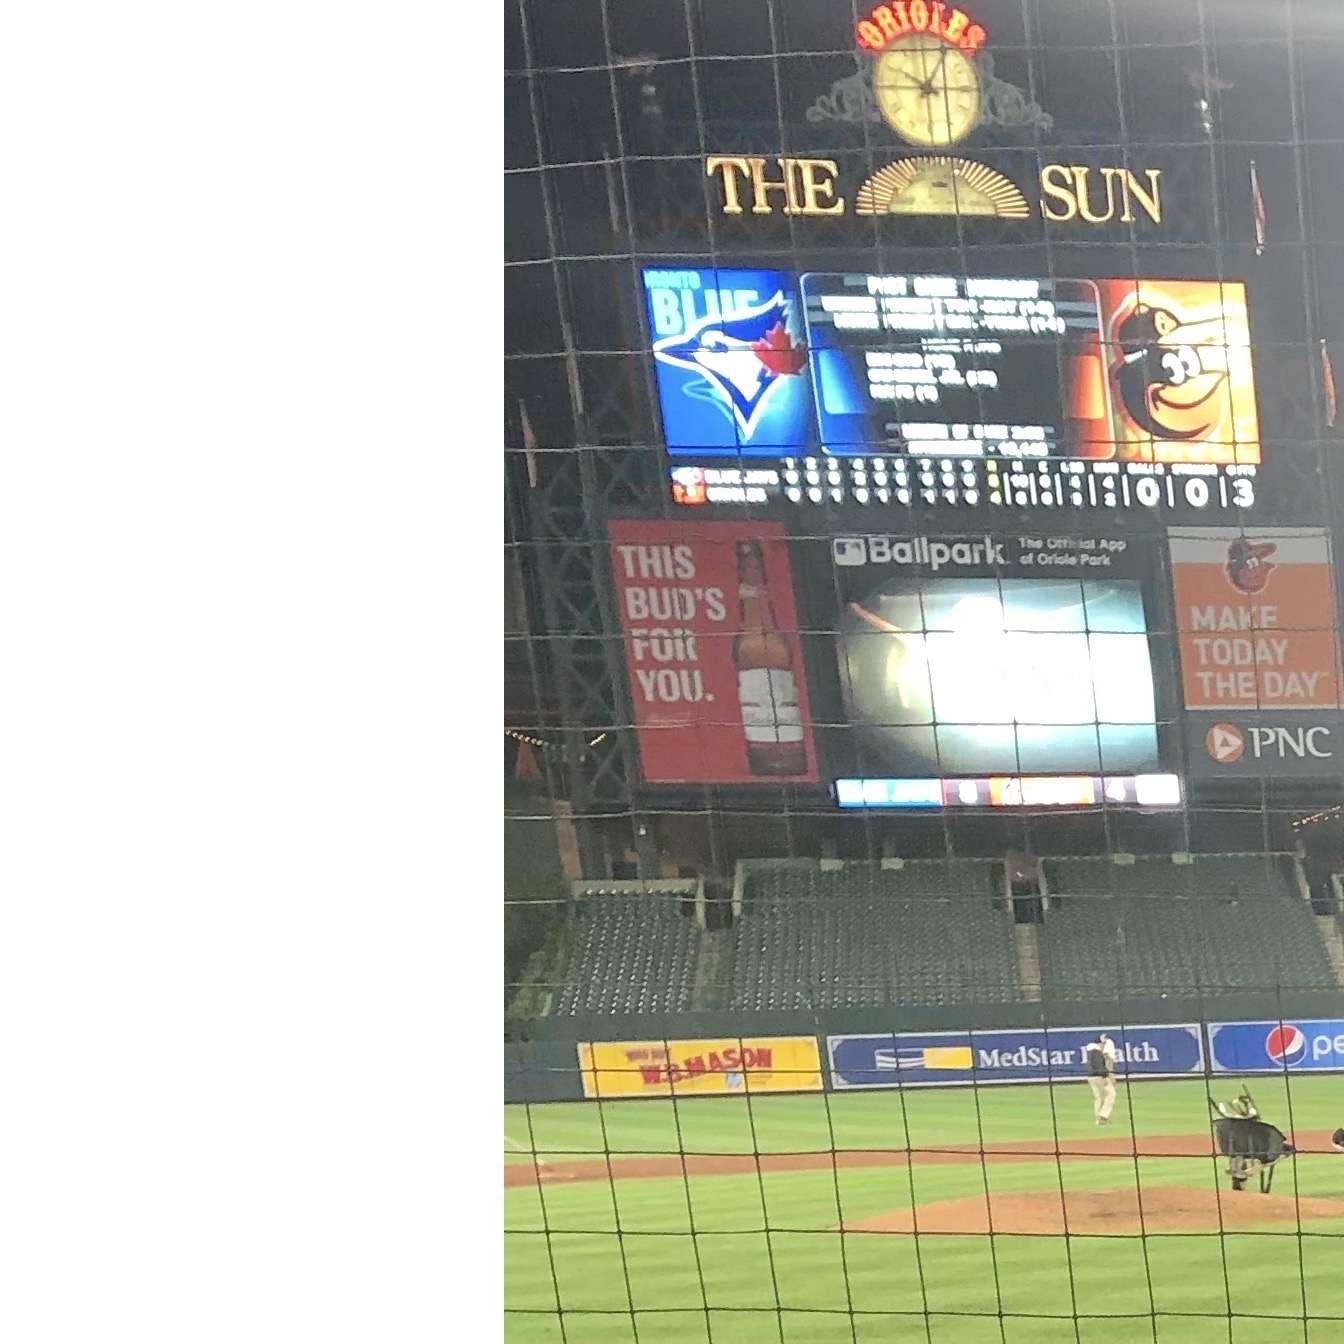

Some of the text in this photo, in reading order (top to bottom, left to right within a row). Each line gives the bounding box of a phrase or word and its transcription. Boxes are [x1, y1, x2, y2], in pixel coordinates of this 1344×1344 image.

[857, 0, 986, 53] ORIOLES
[706, 156, 1161, 223] THE SUN
[1136, 477, 1160, 507] 0
[1185, 477, 1209, 507] 0
[1233, 478, 1255, 508] 3
[868, 536, 1006, 571] Ballpark
[1018, 537, 1043, 549] The
[1100, 538, 1127, 552] App
[1037, 552, 1078, 566] Oriole
[1080, 553, 1111, 566] Park
[617, 544, 696, 579] THIS
[624, 586, 727, 622] BUD'S
[1189, 605, 1279, 631] MAKE
[631, 627, 698, 663] FOR
[1193, 638, 1289, 666] TODAY
[635, 669, 715, 702] YOU.
[1196, 671, 1320, 699] THE DAY
[1247, 726, 1333, 758] PNC
[978, 1041, 1160, 1069] MedStar alth
